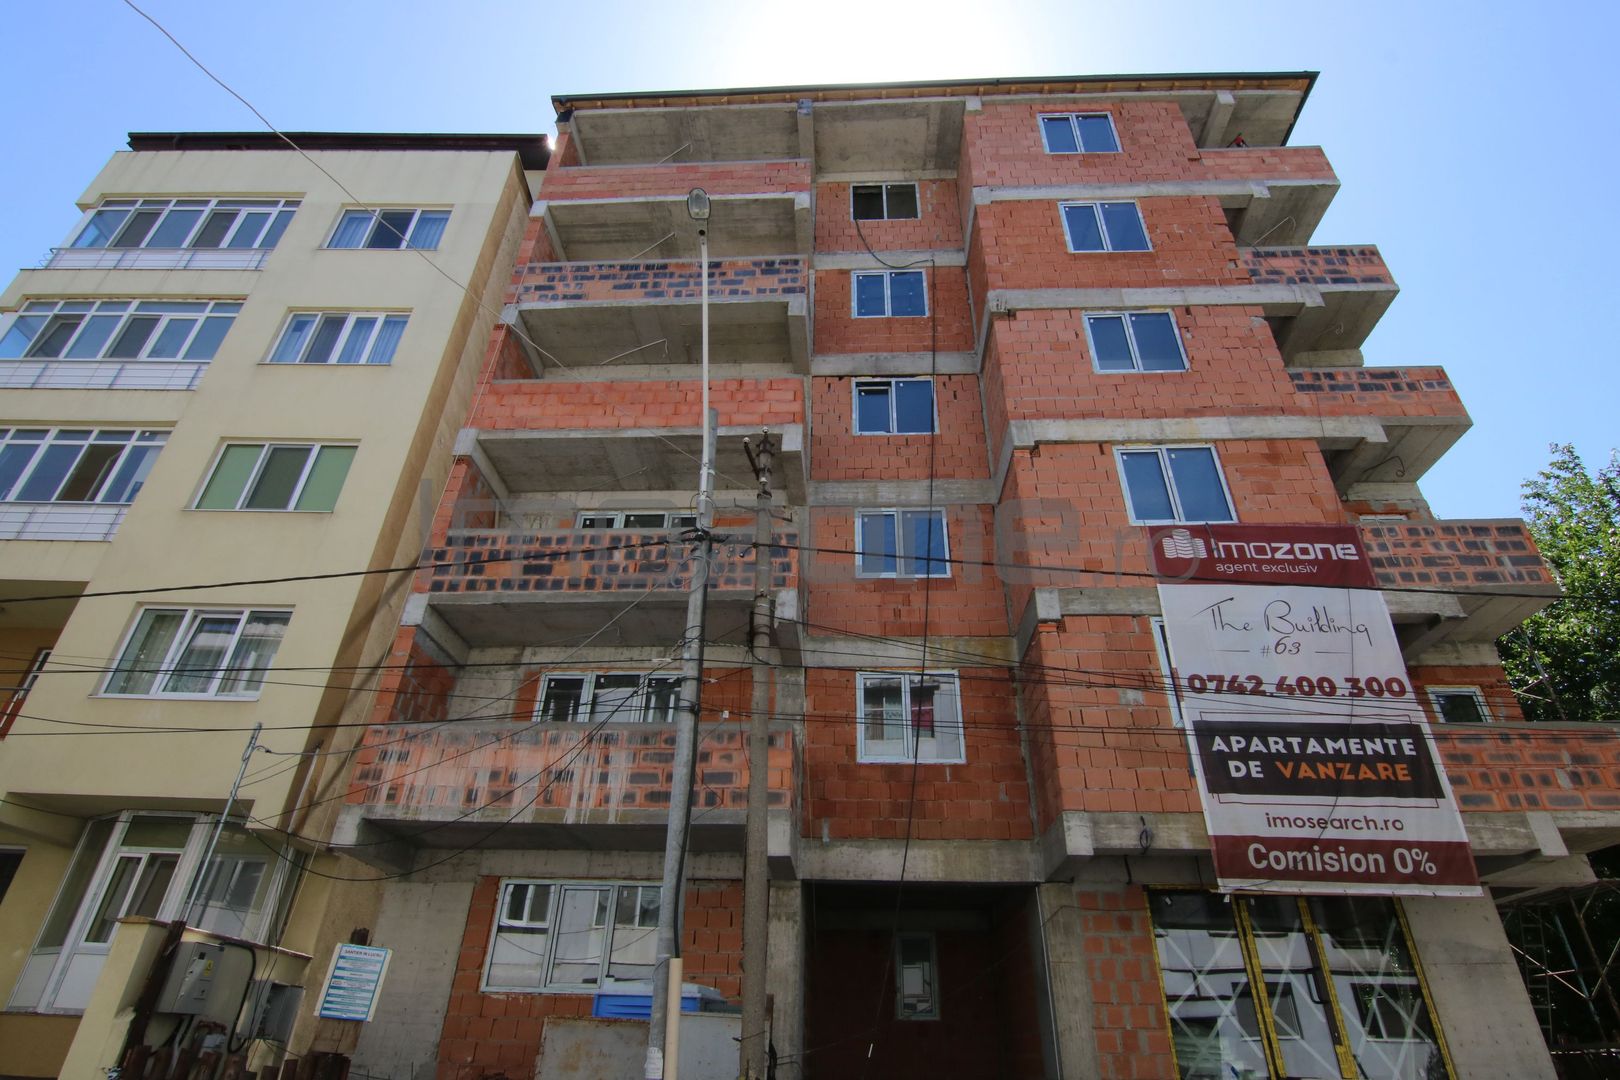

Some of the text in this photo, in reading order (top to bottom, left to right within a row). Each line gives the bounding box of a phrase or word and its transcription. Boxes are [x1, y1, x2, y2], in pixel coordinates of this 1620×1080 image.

[1215, 562, 1318, 574] agent exclusiv
[1190, 597, 1373, 647] The Building
[1260, 635, 1301, 657] #63
[1187, 673, 1407, 697] 0742.400.300
[1211, 735, 1417, 756] APARTAMENTE
[1227, 760, 1413, 781] DE VANZARE
[1265, 812, 1404, 831] imosearch.ro
[1247, 843, 1438, 875] Comision 0%
